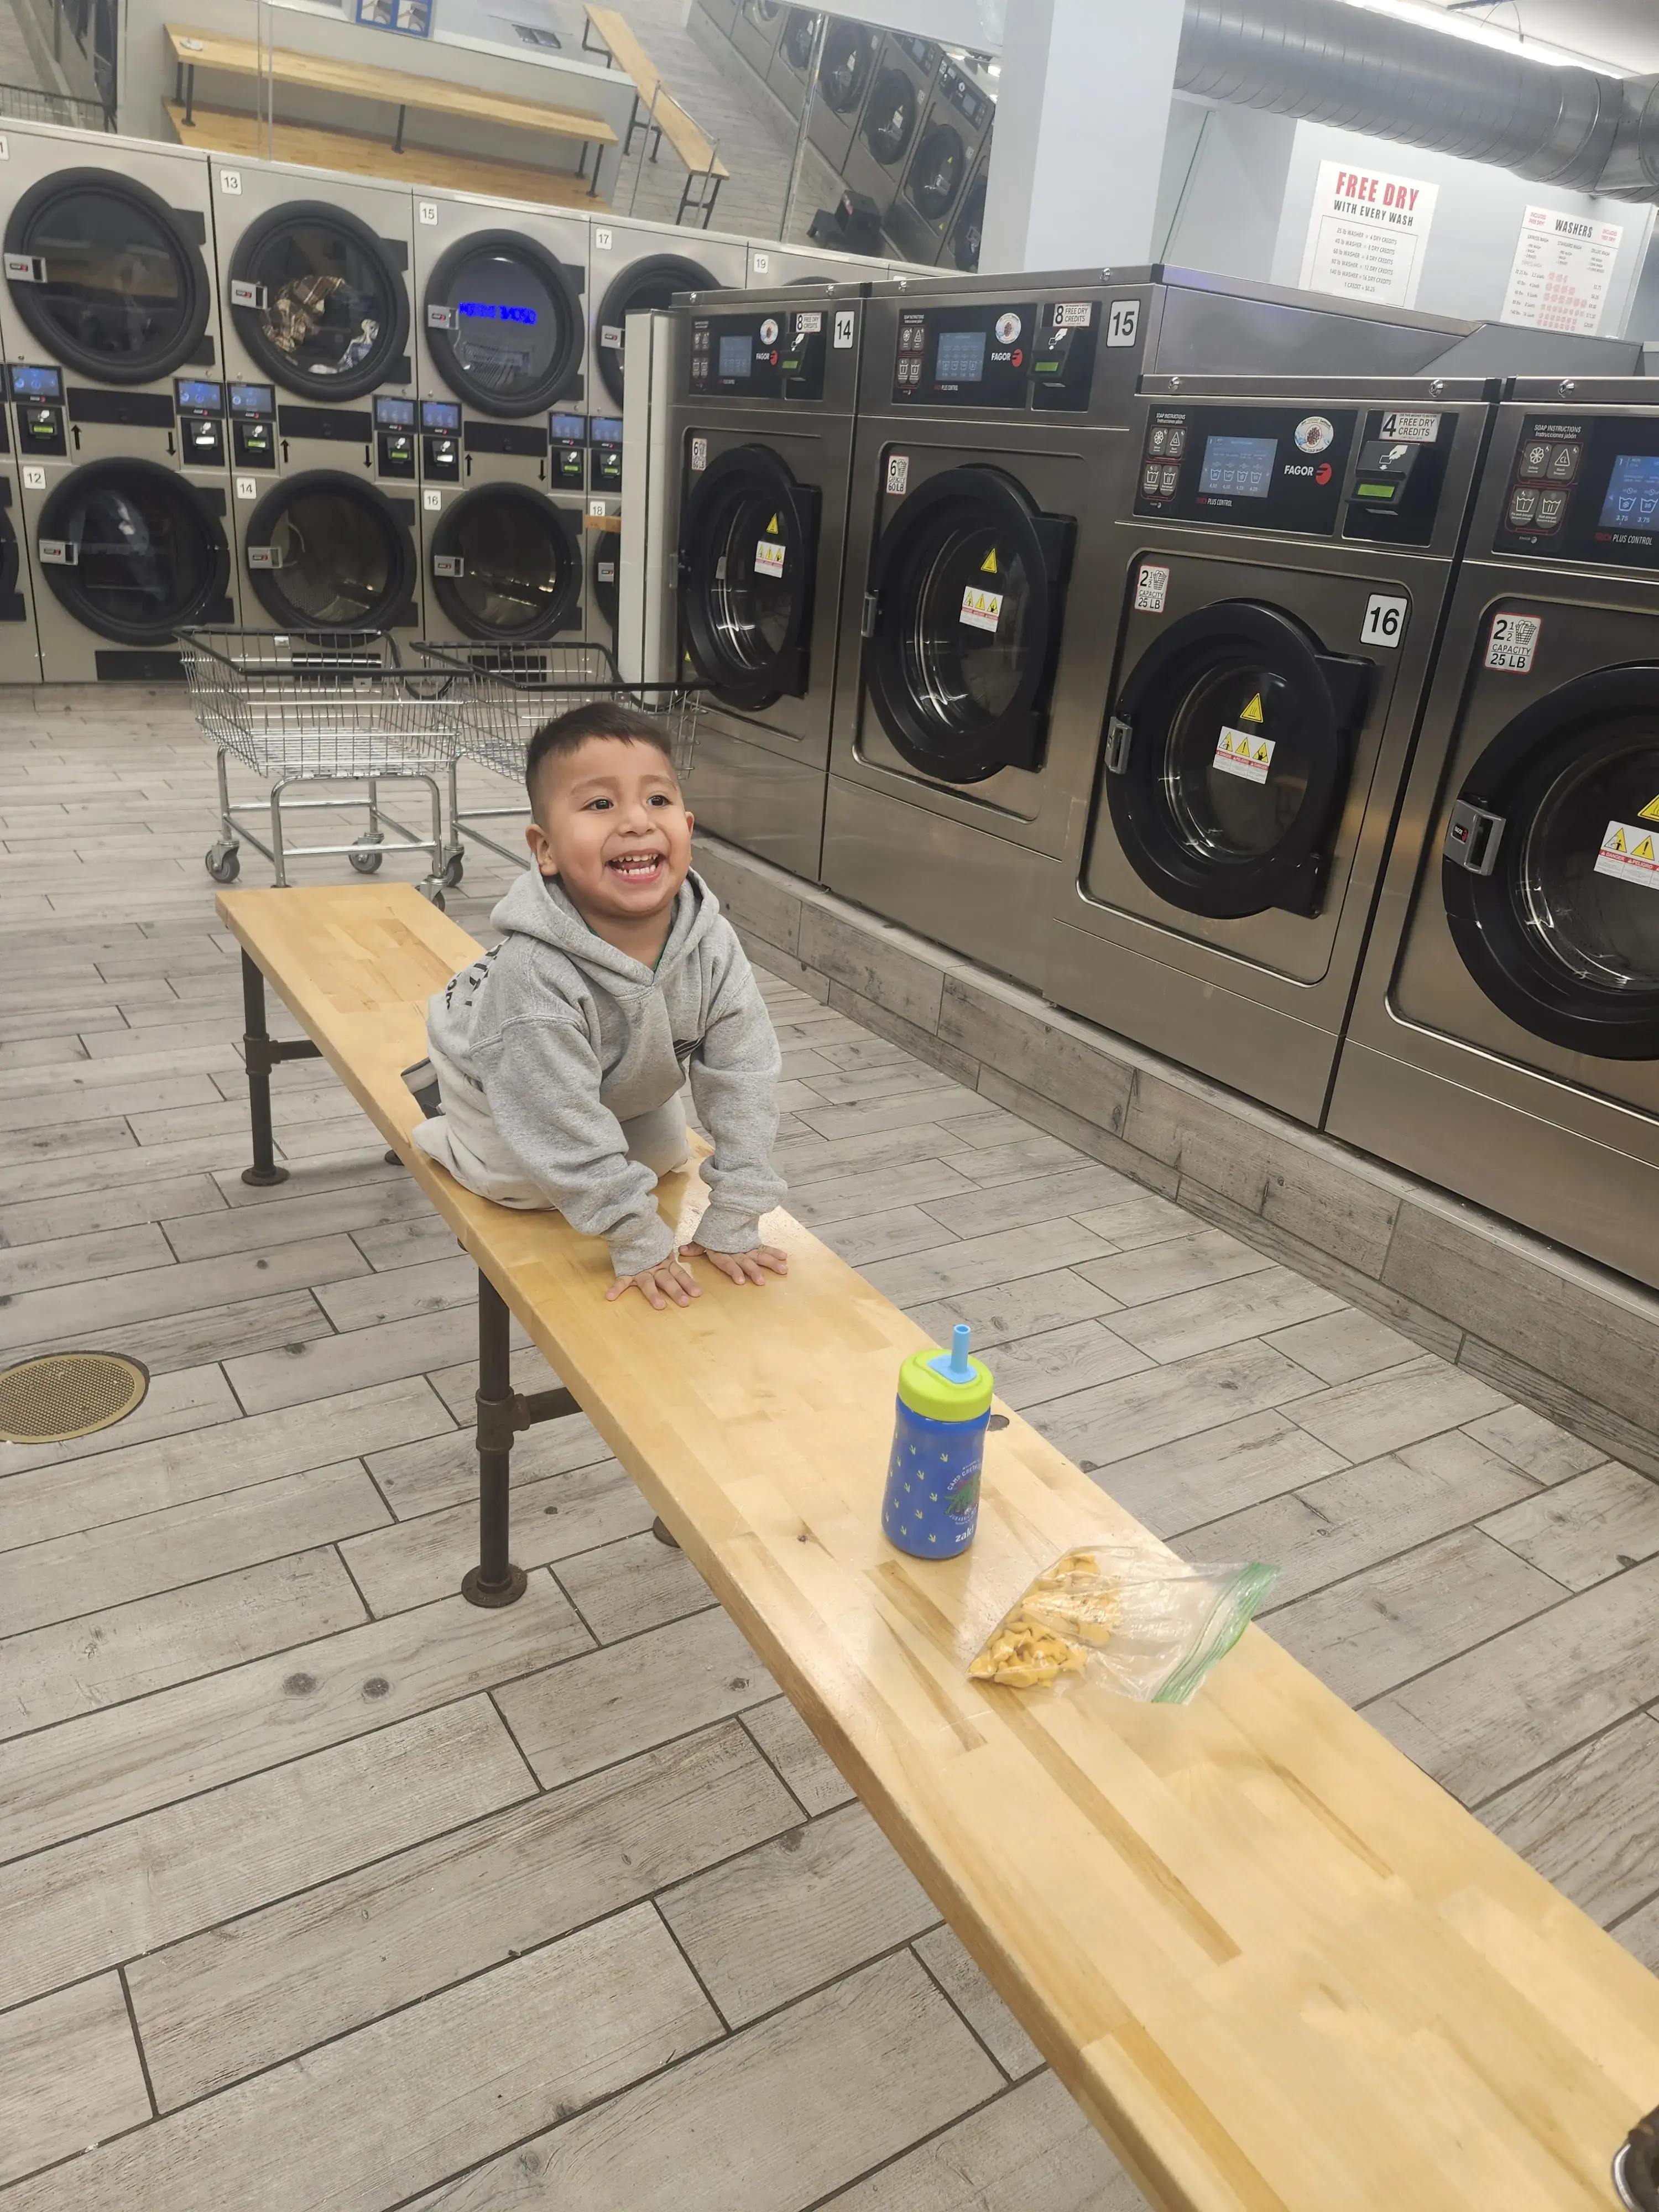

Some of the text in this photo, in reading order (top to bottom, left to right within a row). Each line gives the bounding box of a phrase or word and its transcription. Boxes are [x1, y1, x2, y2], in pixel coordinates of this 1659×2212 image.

[224, 176, 238, 188] 13
[1335, 171, 1420, 211] FREE DRY
[423, 208, 434, 220] 15
[1334, 200, 1413, 226] WITH EVERY WASH
[1555, 219, 1593, 238] WASHERS
[598, 233, 609, 244] 17
[1348, 229, 1364, 238] WASHER
[1382, 237, 1397, 245] CREDITS
[1345, 240, 1362, 248] WASHER
[1343, 250, 1360, 258] WASHER
[757, 258, 766, 269] 19
[1342, 260, 1358, 269] WASHER
[1378, 267, 1394, 275] CREDITS
[1342, 270, 1358, 279] WASHER
[1056, 305, 1064, 325] 8
[797, 315, 803, 330] 8
[1113, 311, 1135, 336] 15
[837, 320, 851, 340] 14
[991, 352, 1011, 361] FAGOR
[1383, 414, 1397, 437] 4
[1399, 418, 1435, 427] FREE DRY
[1399, 427, 1430, 436] CREDITS
[694, 441, 698, 456] 6
[890, 460, 896, 476] 6
[1284, 465, 1314, 476] FAGOR
[28, 473, 41, 484] 12
[241, 483, 253, 494] 14
[888, 483, 904, 492] 60 LB
[427, 495, 439, 505] 16
[1217, 499, 1232, 507] CONTROL
[593, 506, 603, 515] 18
[1613, 534, 1627, 543] PLUS
[1627, 535, 1652, 545] CONTROL
[1140, 570, 1149, 587] 2
[1139, 589, 1164, 598] CAPACITY
[1138, 597, 1160, 609] 25 LB
[1370, 607, 1400, 635] 16
[1493, 619, 1507, 640] 2
[1492, 644, 1531, 655] CAPACITY
[1490, 653, 1526, 669] 25 LB
[1606, 852, 1653, 869] DANGER PELIGRO
[947, 1475, 961, 1490] CAMP
[955, 1524, 974, 1543] zak!
